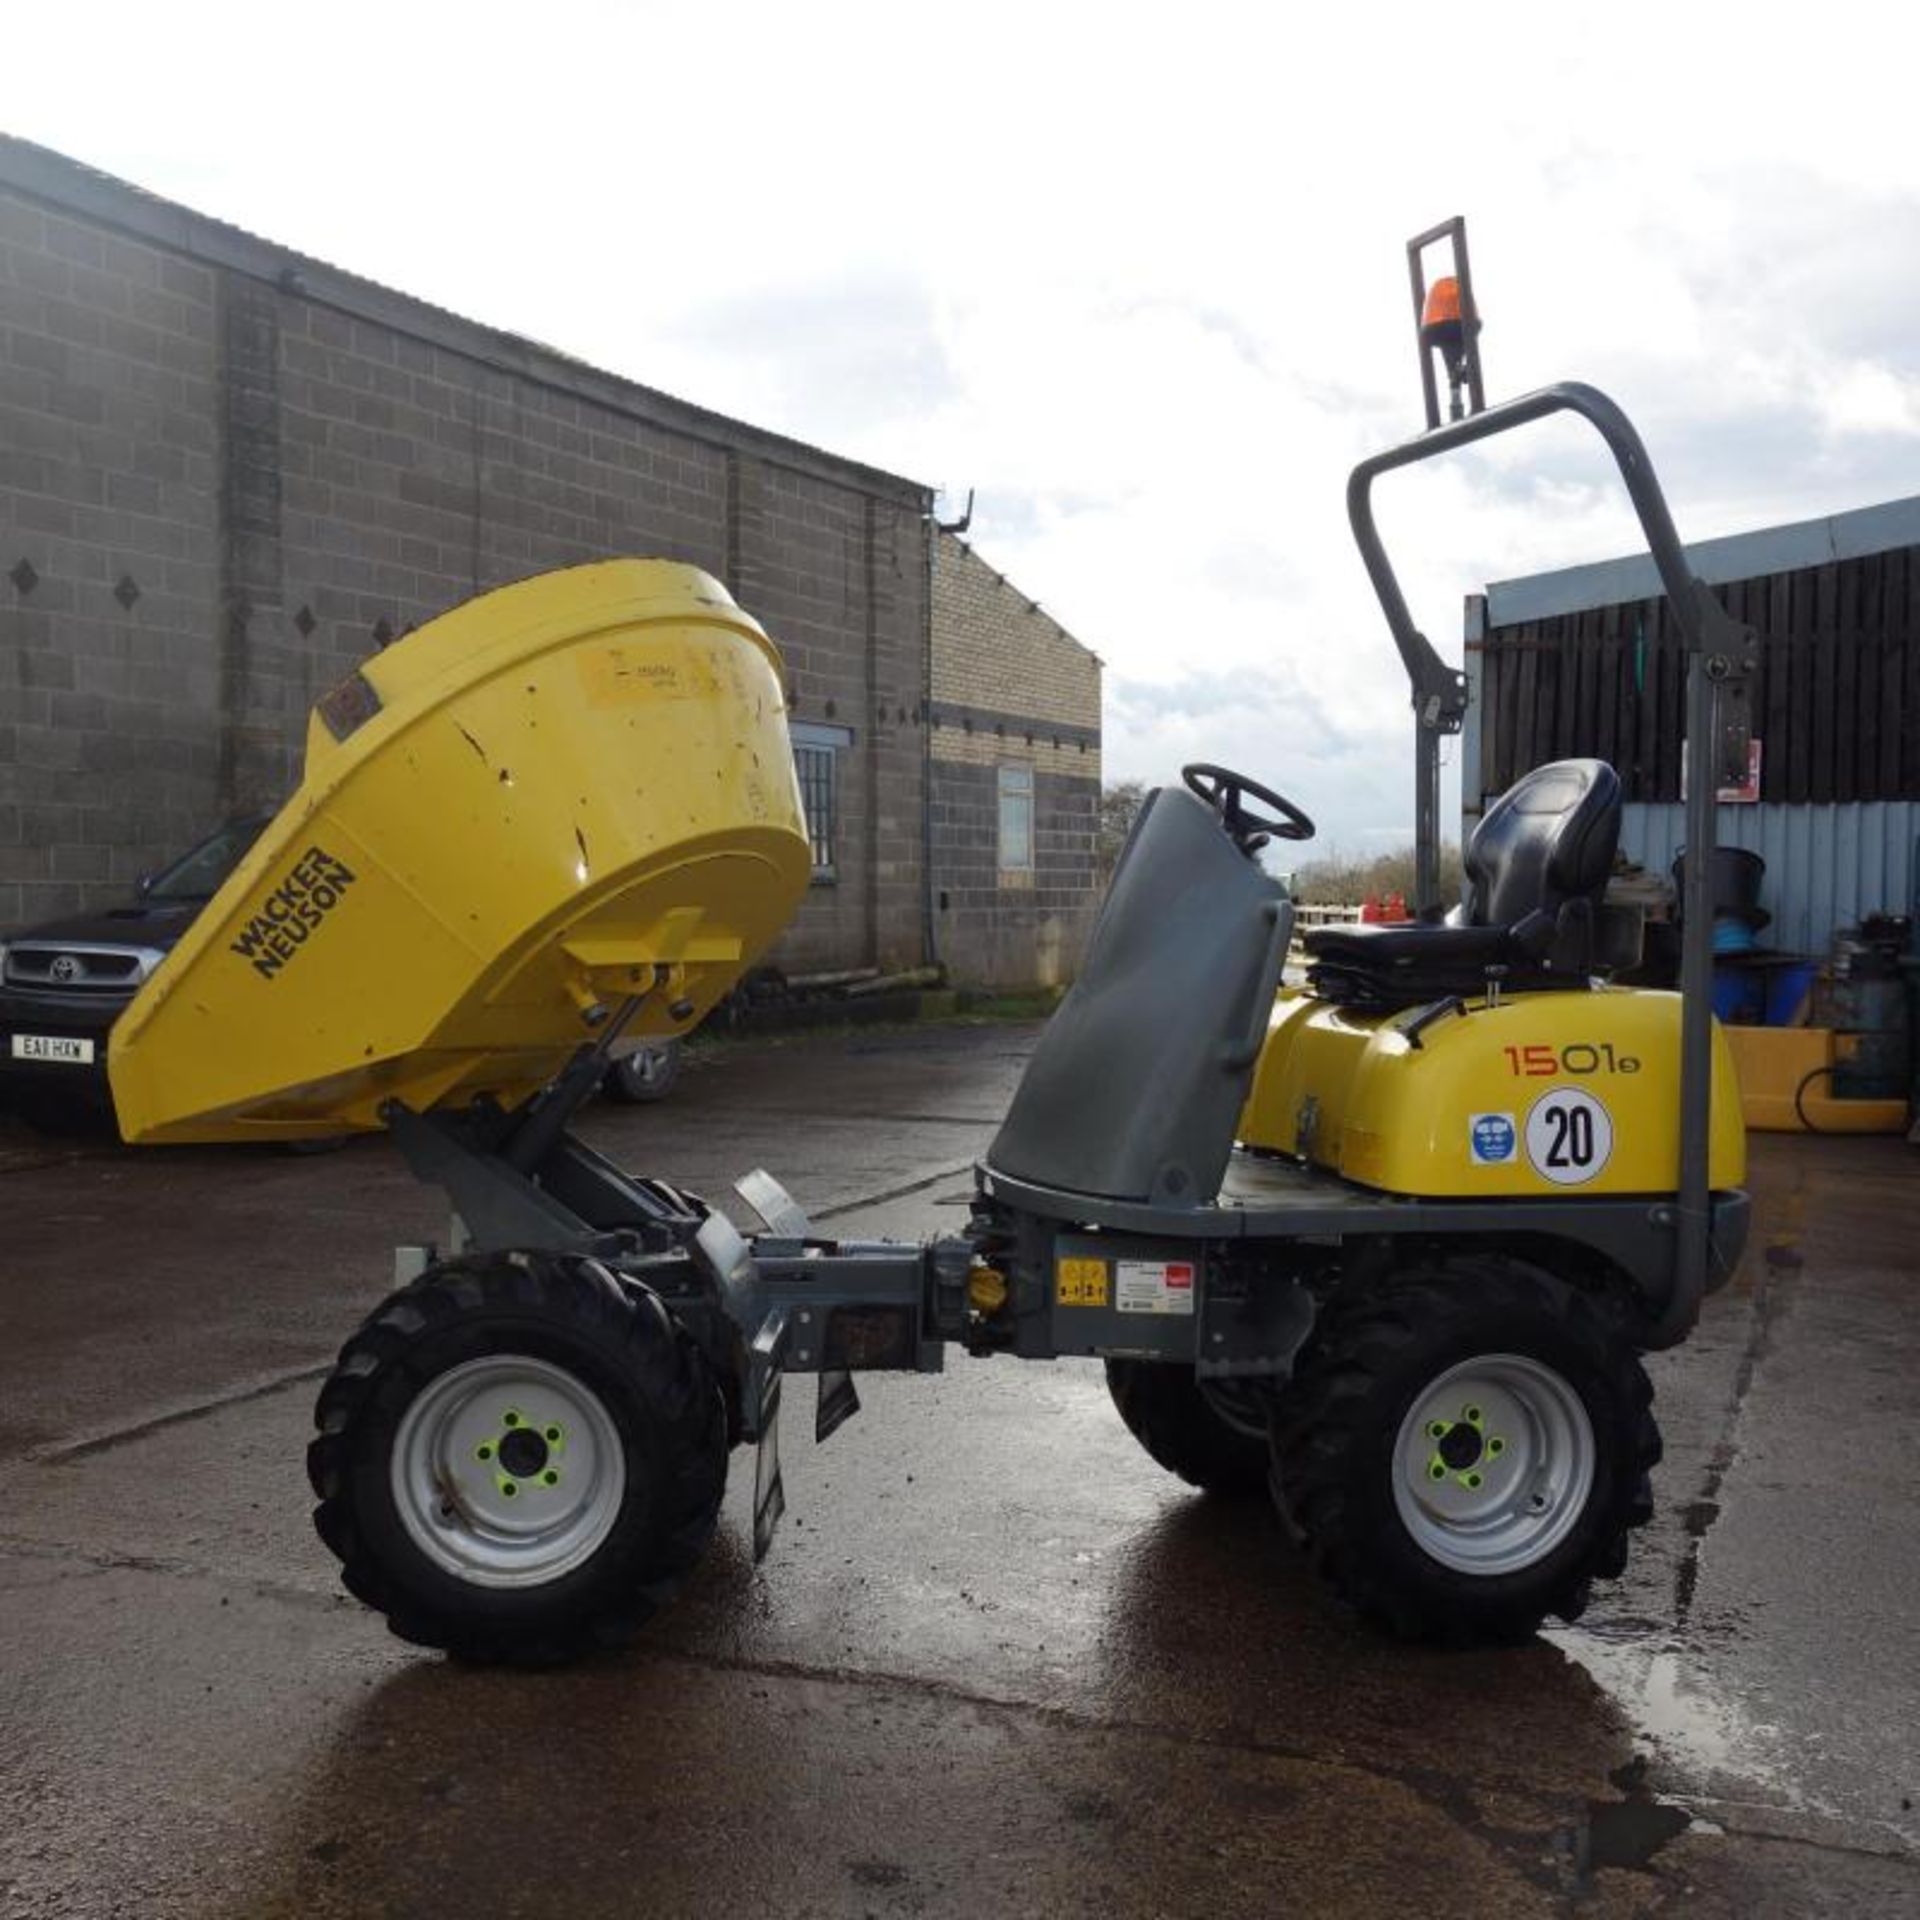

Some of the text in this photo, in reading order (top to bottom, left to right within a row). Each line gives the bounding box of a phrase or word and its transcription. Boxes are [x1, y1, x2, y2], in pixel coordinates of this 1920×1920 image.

[230, 846, 333, 957] WACKER
[252, 862, 355, 979] NEUSON
[1545, 1105, 1593, 1167] 20
